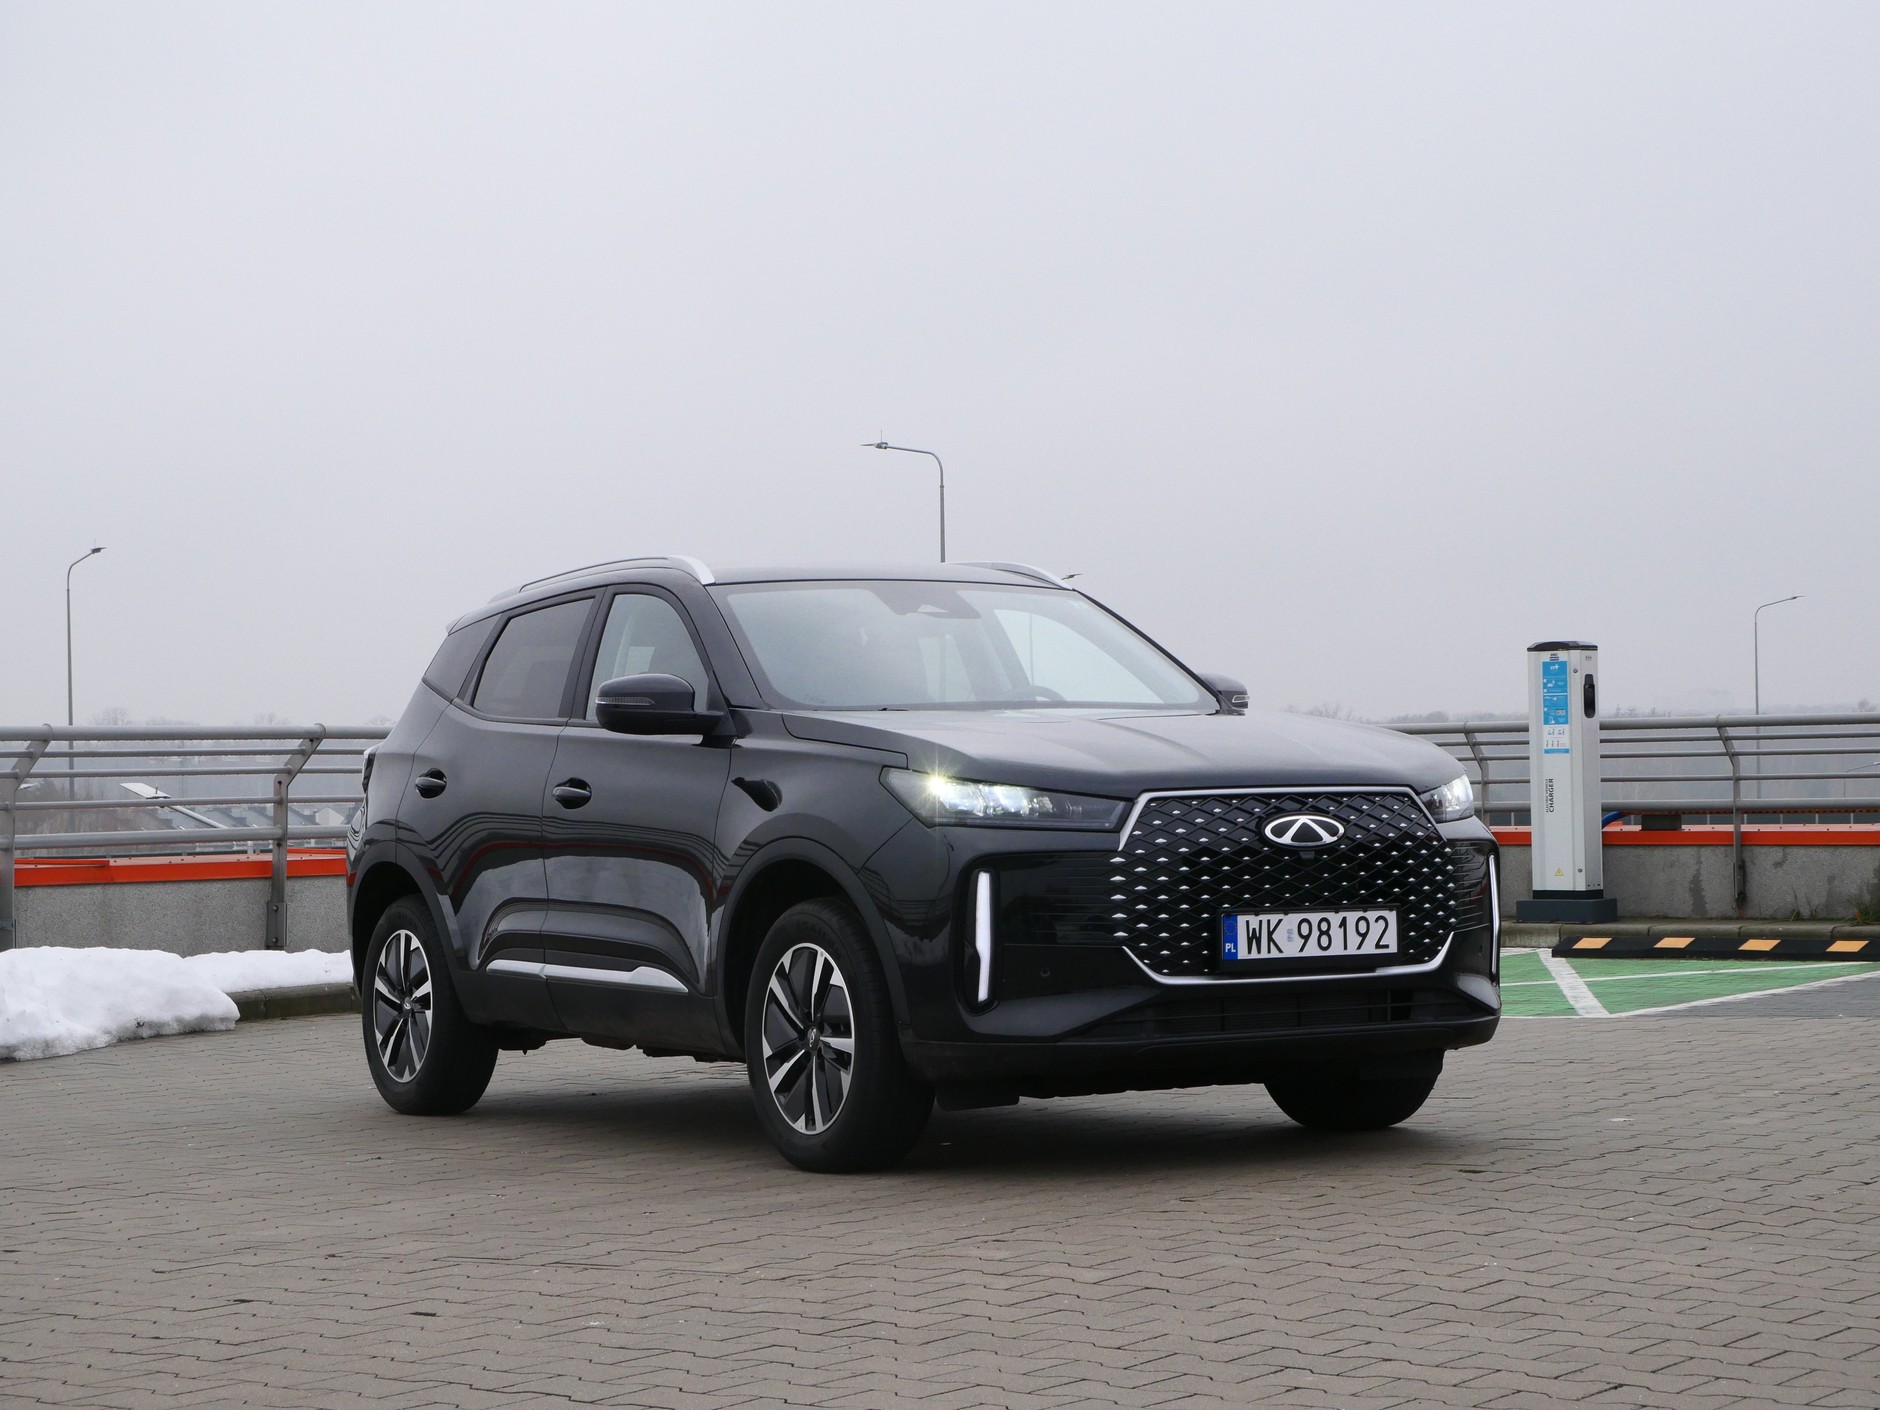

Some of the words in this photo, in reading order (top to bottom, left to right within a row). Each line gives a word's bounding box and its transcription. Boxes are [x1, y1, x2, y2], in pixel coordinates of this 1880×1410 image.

[1246, 918, 1284, 955] WK
[1297, 915, 1390, 953] 98192
[1225, 943, 1236, 953] PL
